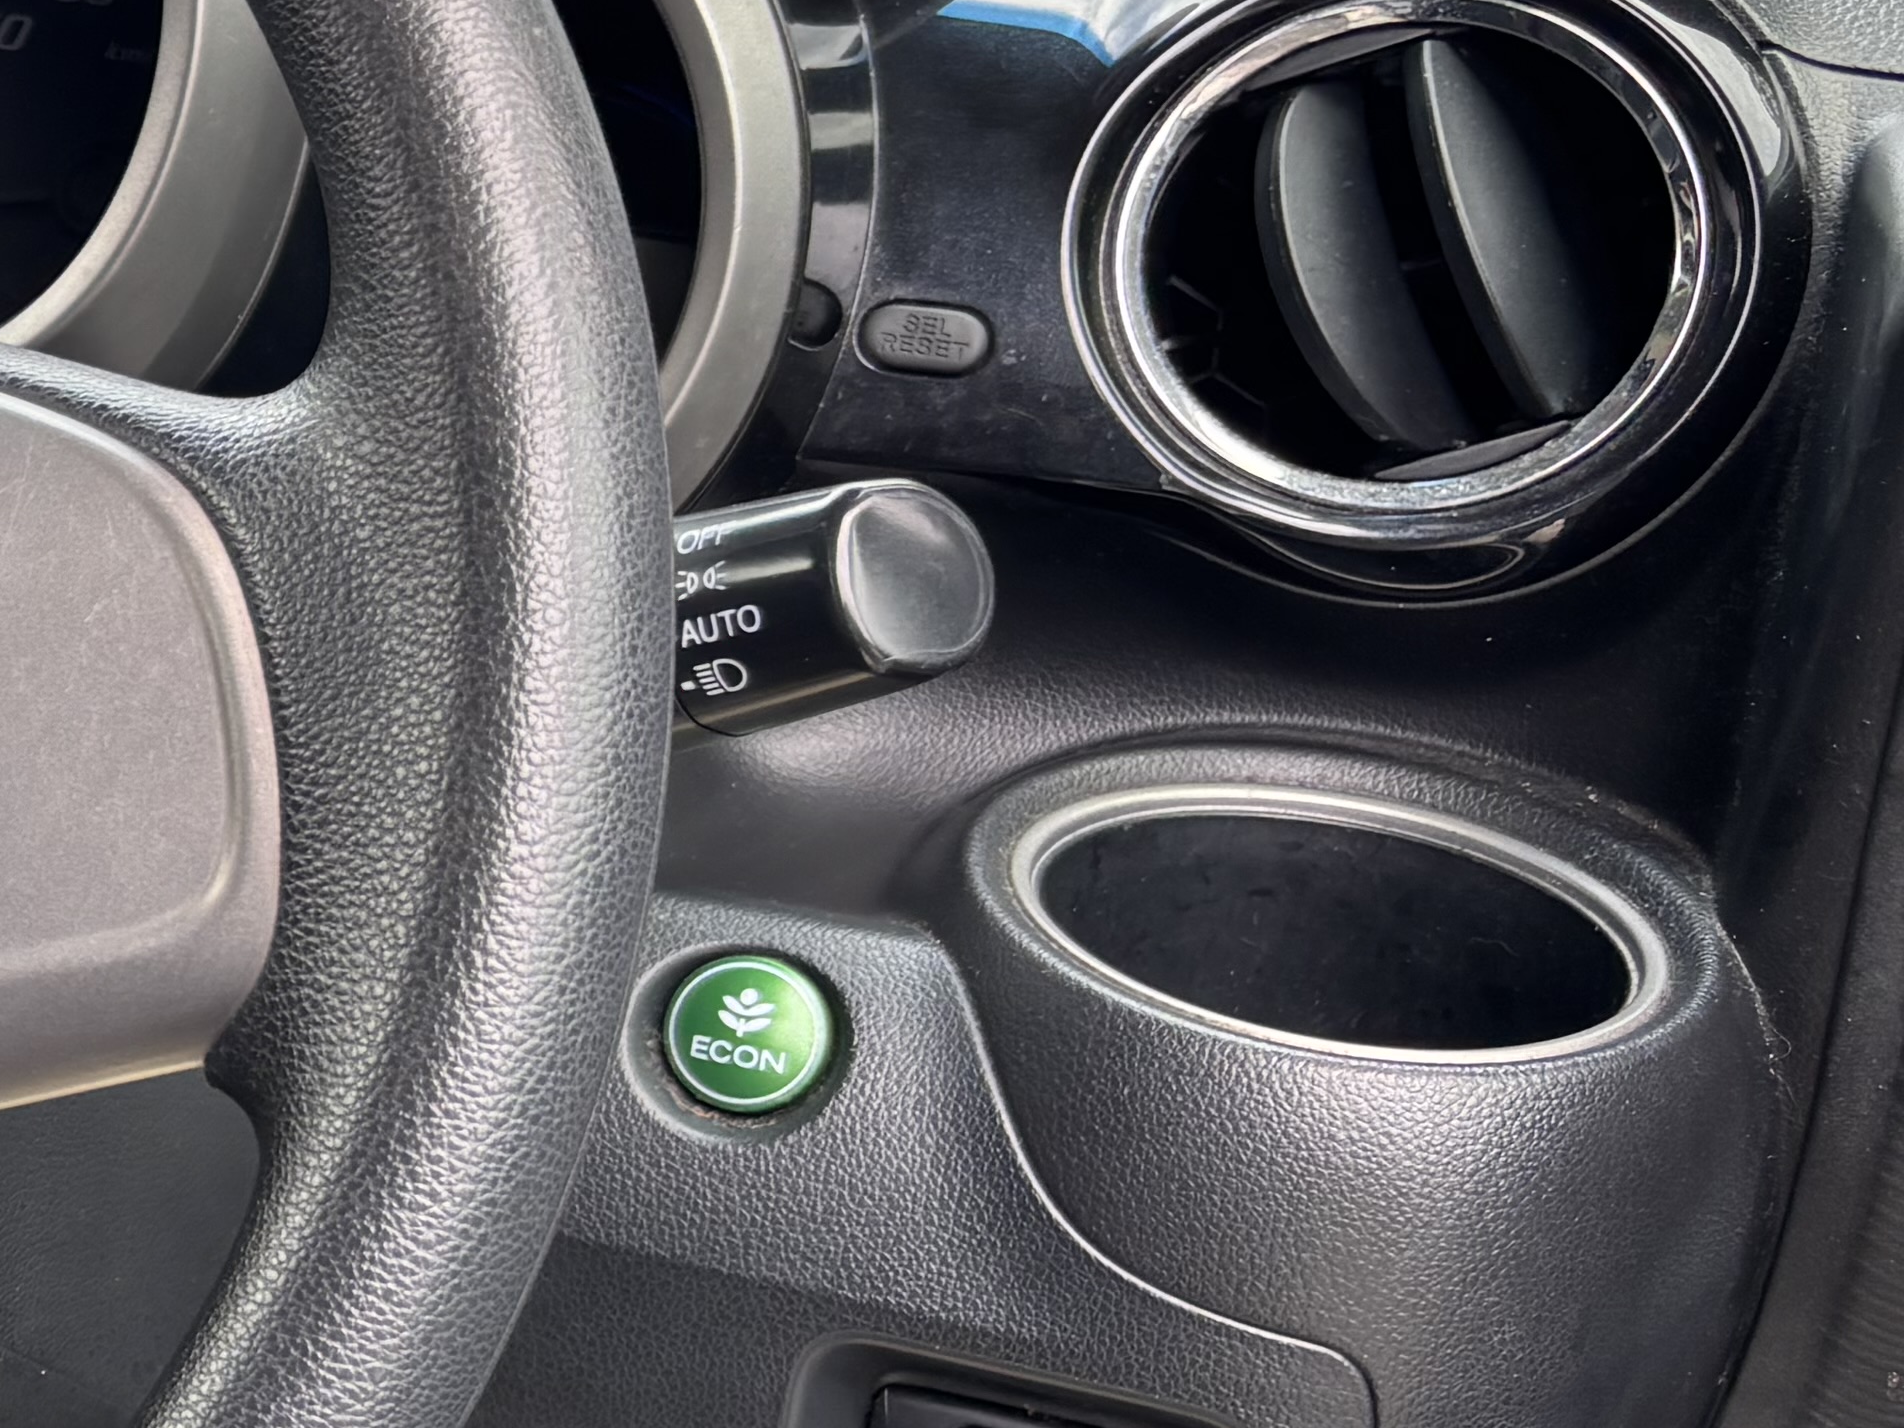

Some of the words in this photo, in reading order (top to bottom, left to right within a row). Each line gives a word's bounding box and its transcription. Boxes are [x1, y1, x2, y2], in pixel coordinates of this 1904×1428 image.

[903, 313, 952, 338] SEL
[880, 331, 970, 361] RESET
[677, 520, 737, 554] OFF
[681, 604, 761, 648] AUTO
[690, 1034, 786, 1074] ECON
